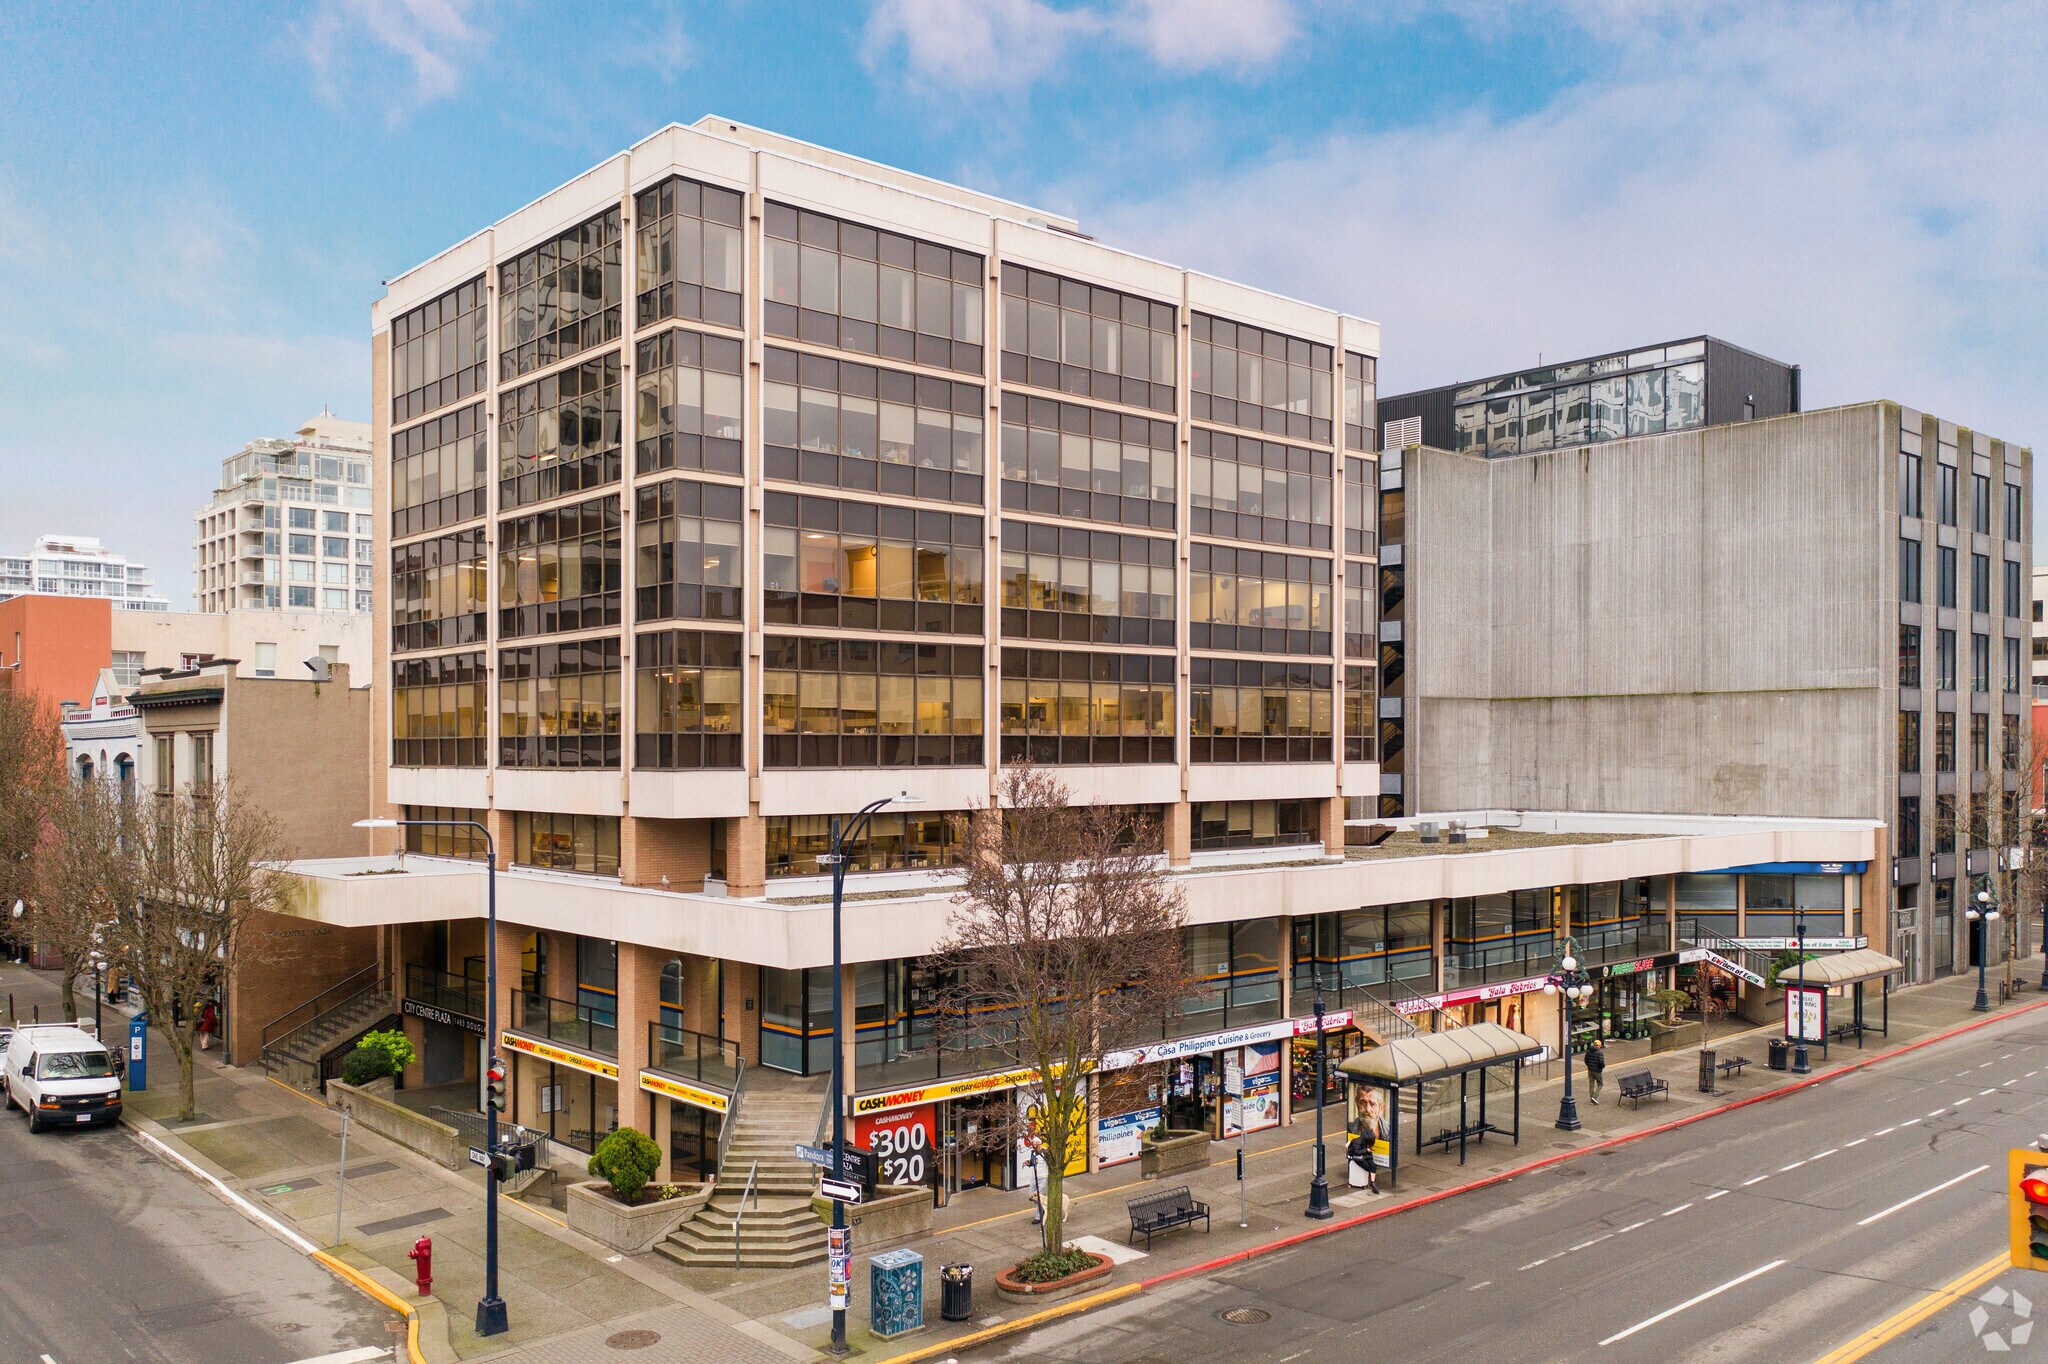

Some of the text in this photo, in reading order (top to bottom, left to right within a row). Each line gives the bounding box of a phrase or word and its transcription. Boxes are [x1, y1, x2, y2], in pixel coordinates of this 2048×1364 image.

[281, 929, 306, 938] CENTRE
[1711, 956, 1735, 972] Grden
[1488, 981, 1538, 998] Gala Fabrics
[404, 1002, 452, 1025] CITY CENTRE PLAZA
[134, 1026, 141, 1034] P
[1301, 1019, 1317, 1031] Gal
[1157, 1046, 1176, 1058] Casa
[1179, 1037, 1216, 1053] Philippine
[1217, 1033, 1244, 1046] Cuisine
[1249, 1030, 1272, 1042] Grocery
[859, 1090, 926, 1112] CASHMONEY
[950, 1083, 973, 1094] PAYDAY
[875, 1112, 914, 1125] CASHMONEY
[869, 1122, 926, 1158] $300
[1098, 1130, 1134, 1143] Philippines
[803, 1149, 824, 1161] Pandora
[883, 1154, 925, 1186] $20
